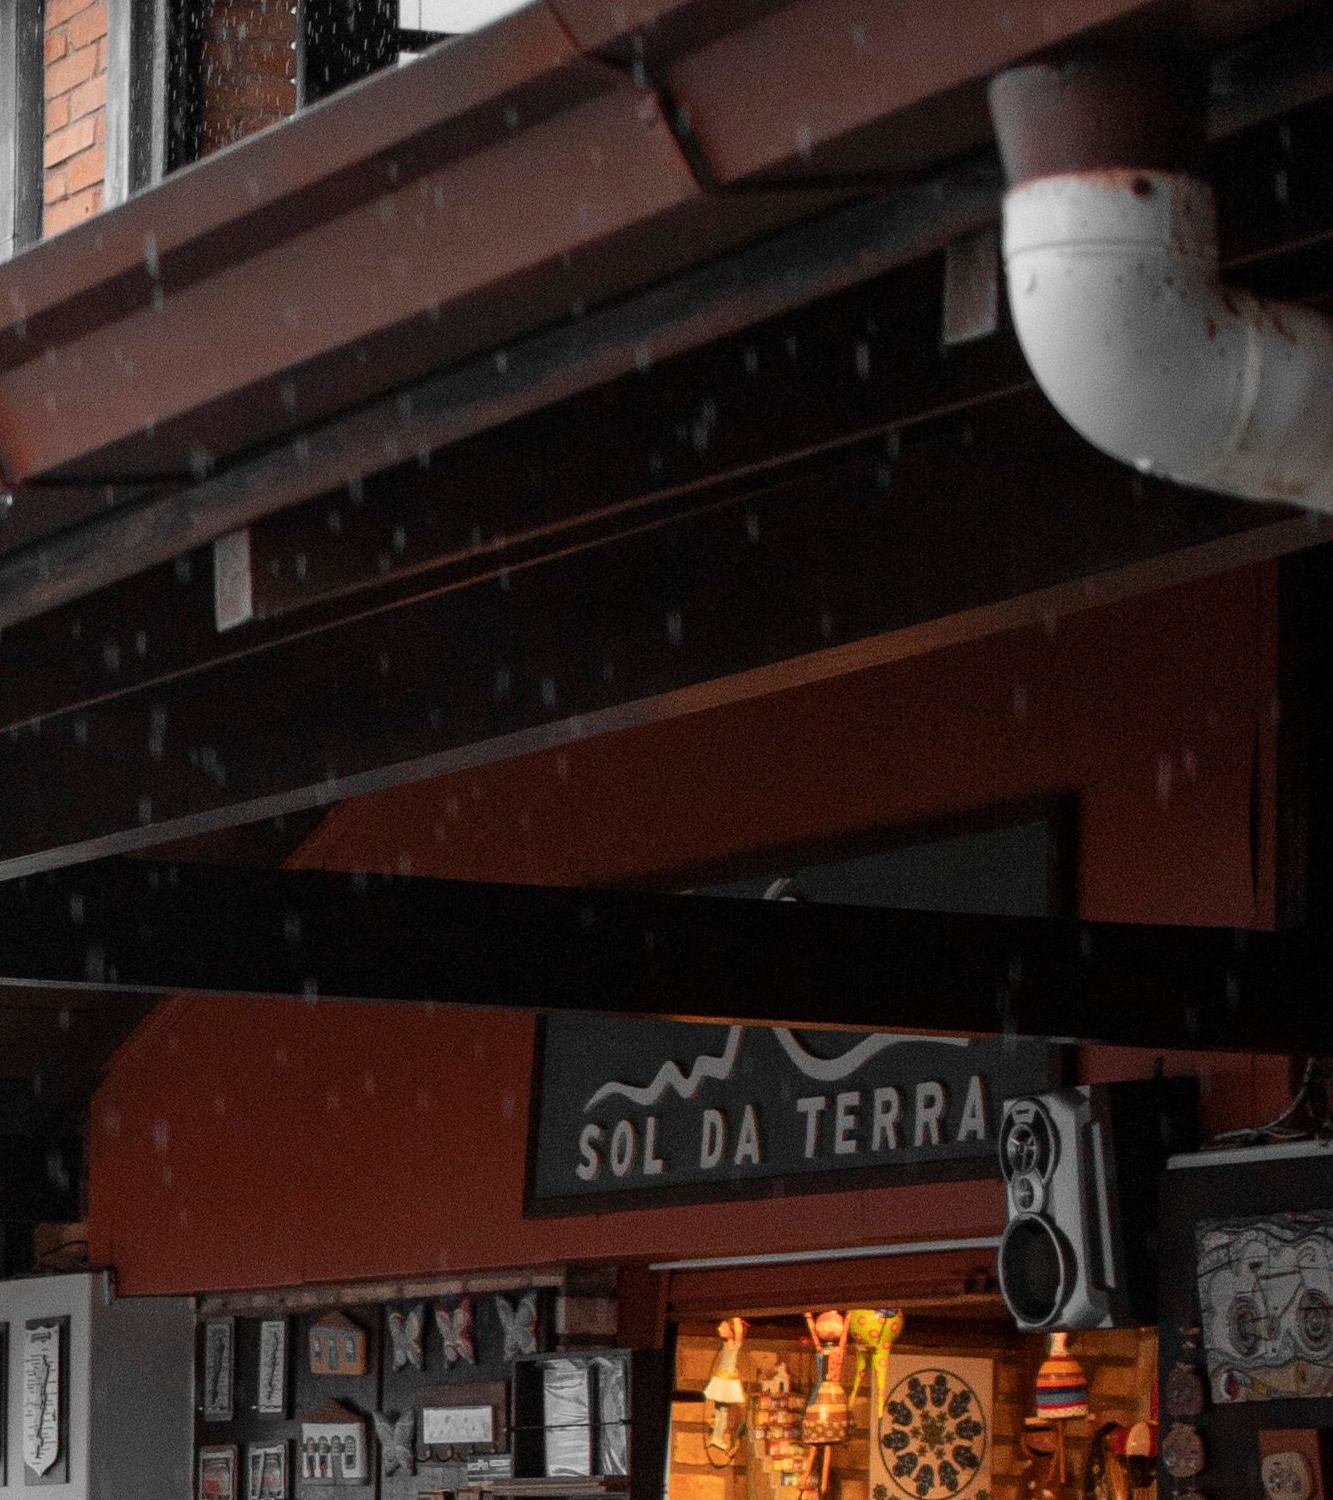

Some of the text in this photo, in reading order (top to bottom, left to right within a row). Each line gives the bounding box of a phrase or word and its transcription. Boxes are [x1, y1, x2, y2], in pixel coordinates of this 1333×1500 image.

[576, 1076, 987, 1181] SOL DA TERRA
